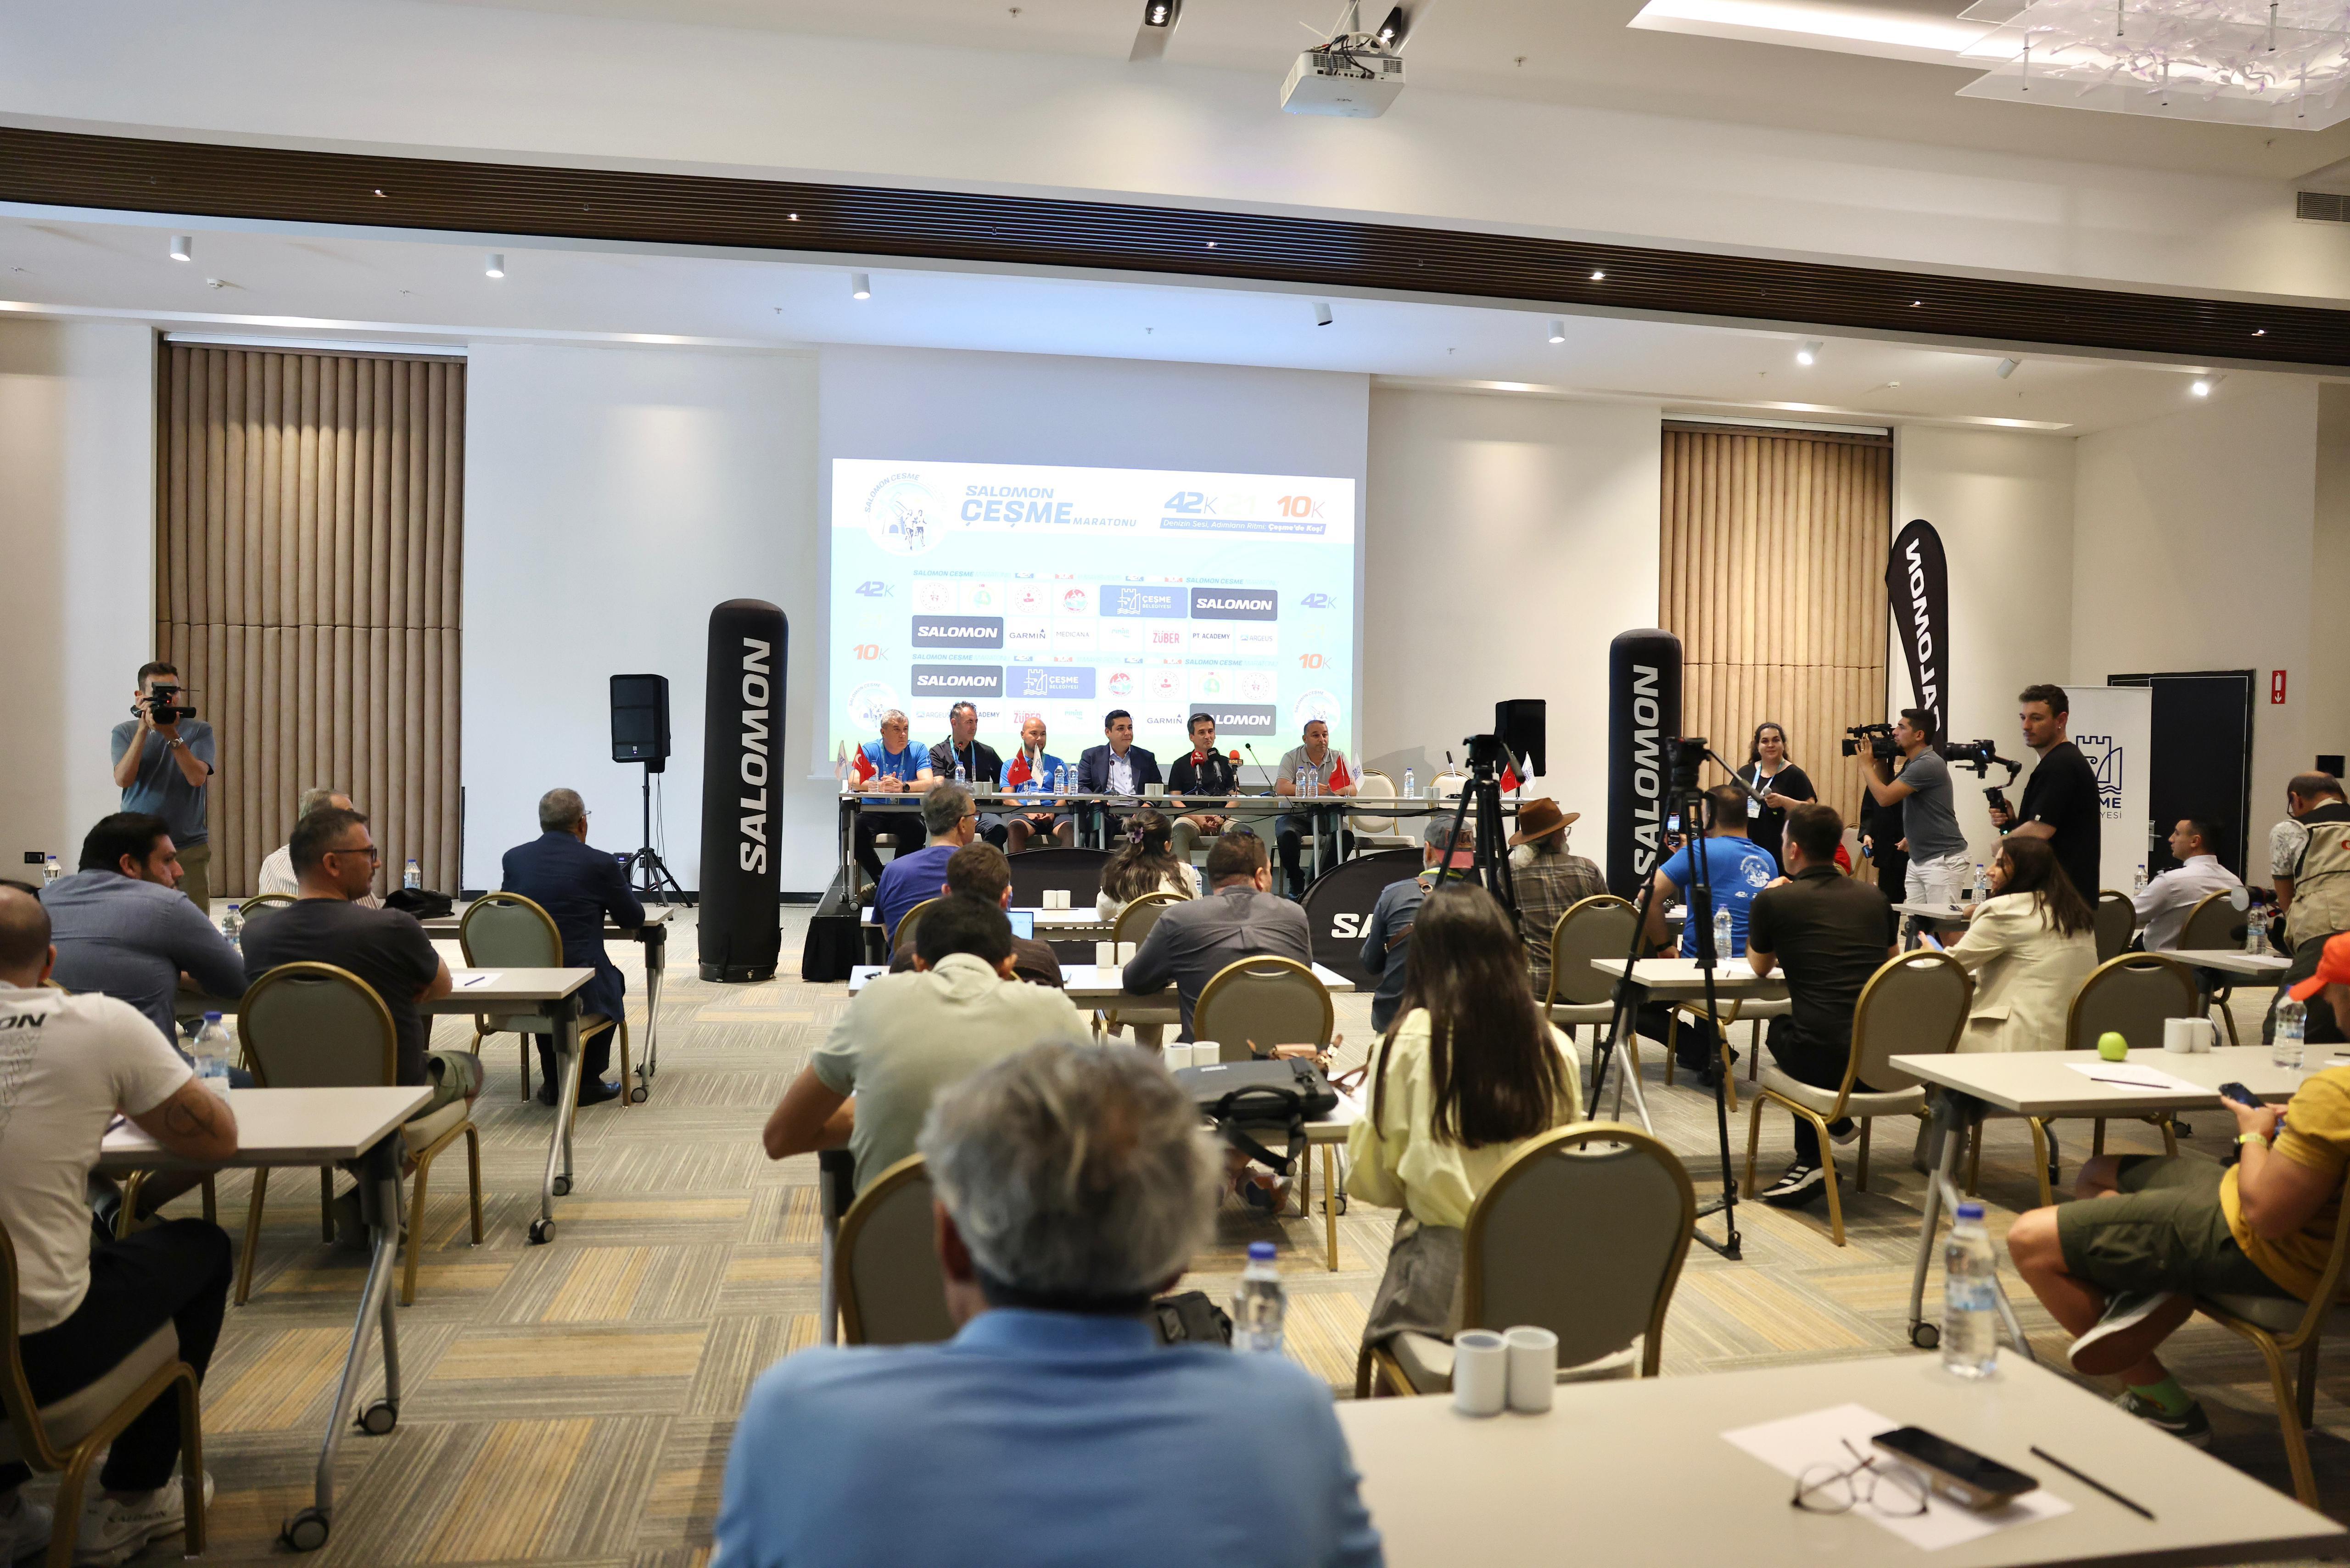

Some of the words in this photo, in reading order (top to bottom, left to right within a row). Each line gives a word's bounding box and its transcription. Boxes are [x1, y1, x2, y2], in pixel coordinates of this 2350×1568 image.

[865, 477, 890, 513] SALOMON
[966, 485, 1054, 499] SALOMON
[961, 499, 1073, 527] ÇEŞME
[1073, 517, 1137, 527] MARATONU
[1164, 492, 1218, 515] 42K
[1277, 495, 1326, 519] 10K
[1268, 523, 1305, 532] Çeşme'de
[856, 581, 894, 597] 42K
[1196, 599, 1272, 610] SALOMON
[1301, 593, 1337, 609] 42K
[918, 626, 998, 638] SALOMON
[853, 644, 890, 661] 10K
[1299, 653, 1332, 670] 10K
[917, 675, 997, 687] SALOMON
[1049, 676, 1079, 684] ÇEŞME
[740, 638, 770, 874] SALOMON
[1634, 664, 1660, 875] SALOMON
